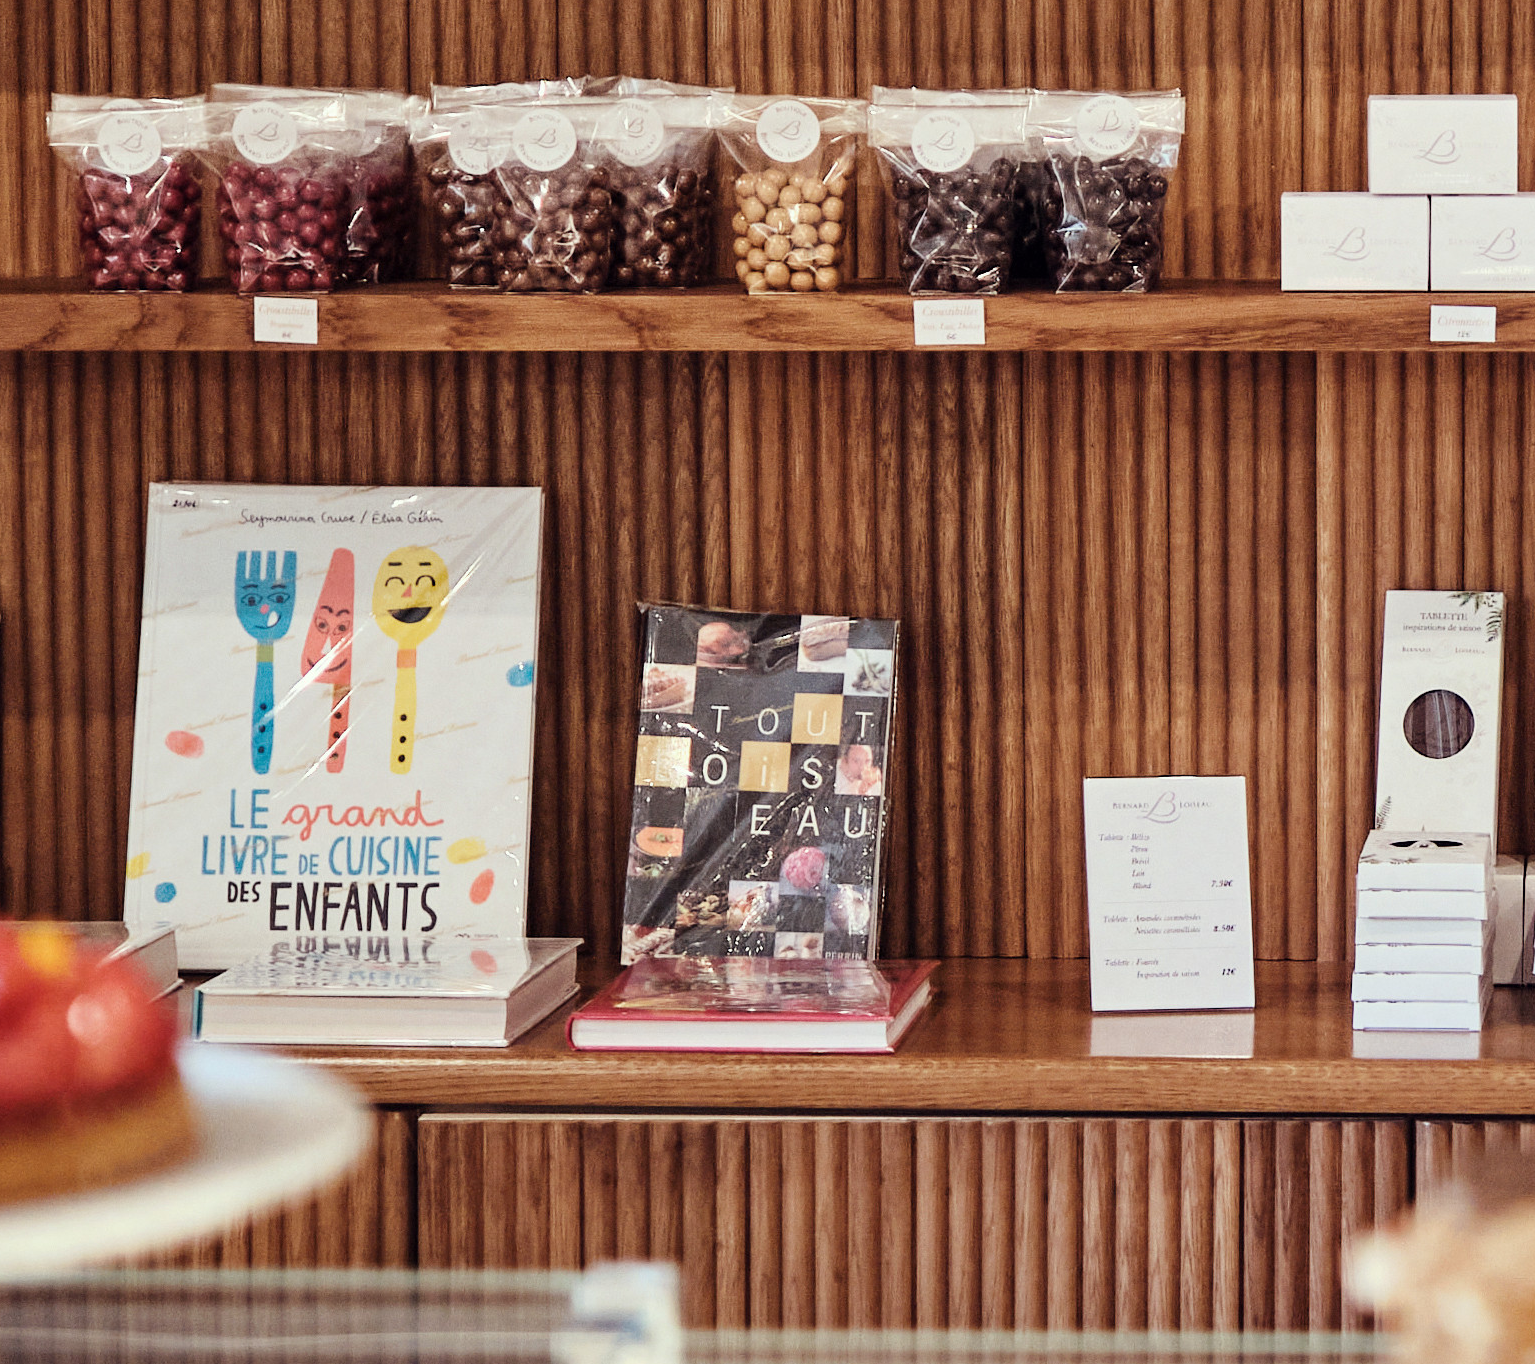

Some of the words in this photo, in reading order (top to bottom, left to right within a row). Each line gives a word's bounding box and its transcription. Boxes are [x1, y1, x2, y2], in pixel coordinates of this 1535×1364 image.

[1420, 612, 1468, 621] TABLETTE
[710, 704, 874, 739] TOUT
[230, 788, 270, 829] LE
[281, 789, 444, 840] grand
[750, 803, 871, 839] EAU
[201, 835, 289, 875] LIVRE
[298, 854, 319, 875] DE
[328, 835, 442, 876] CUISINE
[227, 881, 260, 903] DES
[269, 881, 441, 932] ENFANTS
[1222, 968, 1237, 976] 12€
